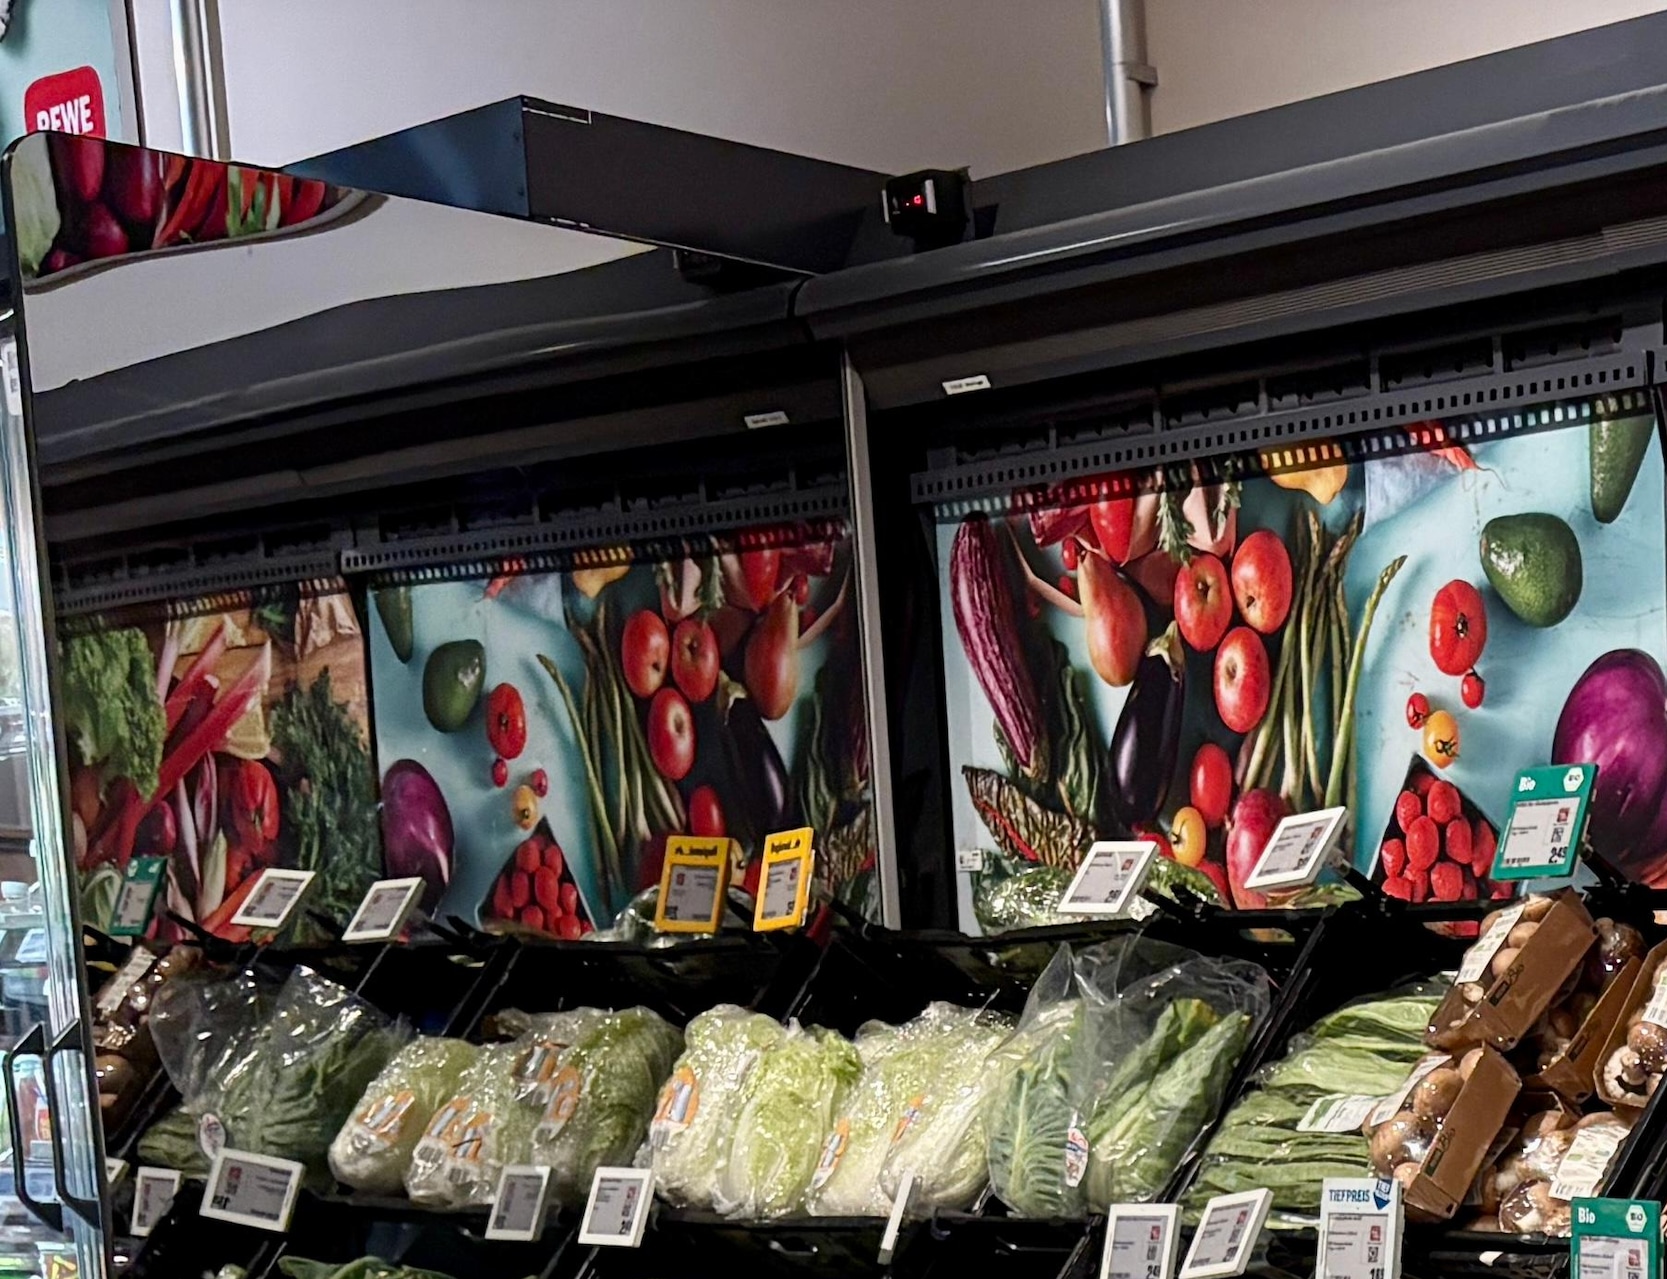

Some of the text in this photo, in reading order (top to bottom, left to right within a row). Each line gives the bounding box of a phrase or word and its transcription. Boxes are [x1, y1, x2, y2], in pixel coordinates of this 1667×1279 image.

[1519, 776, 1536, 792] Bio
[1329, 1189, 1371, 1203] TIEFPREIS
[1577, 1208, 1596, 1225] Bio
